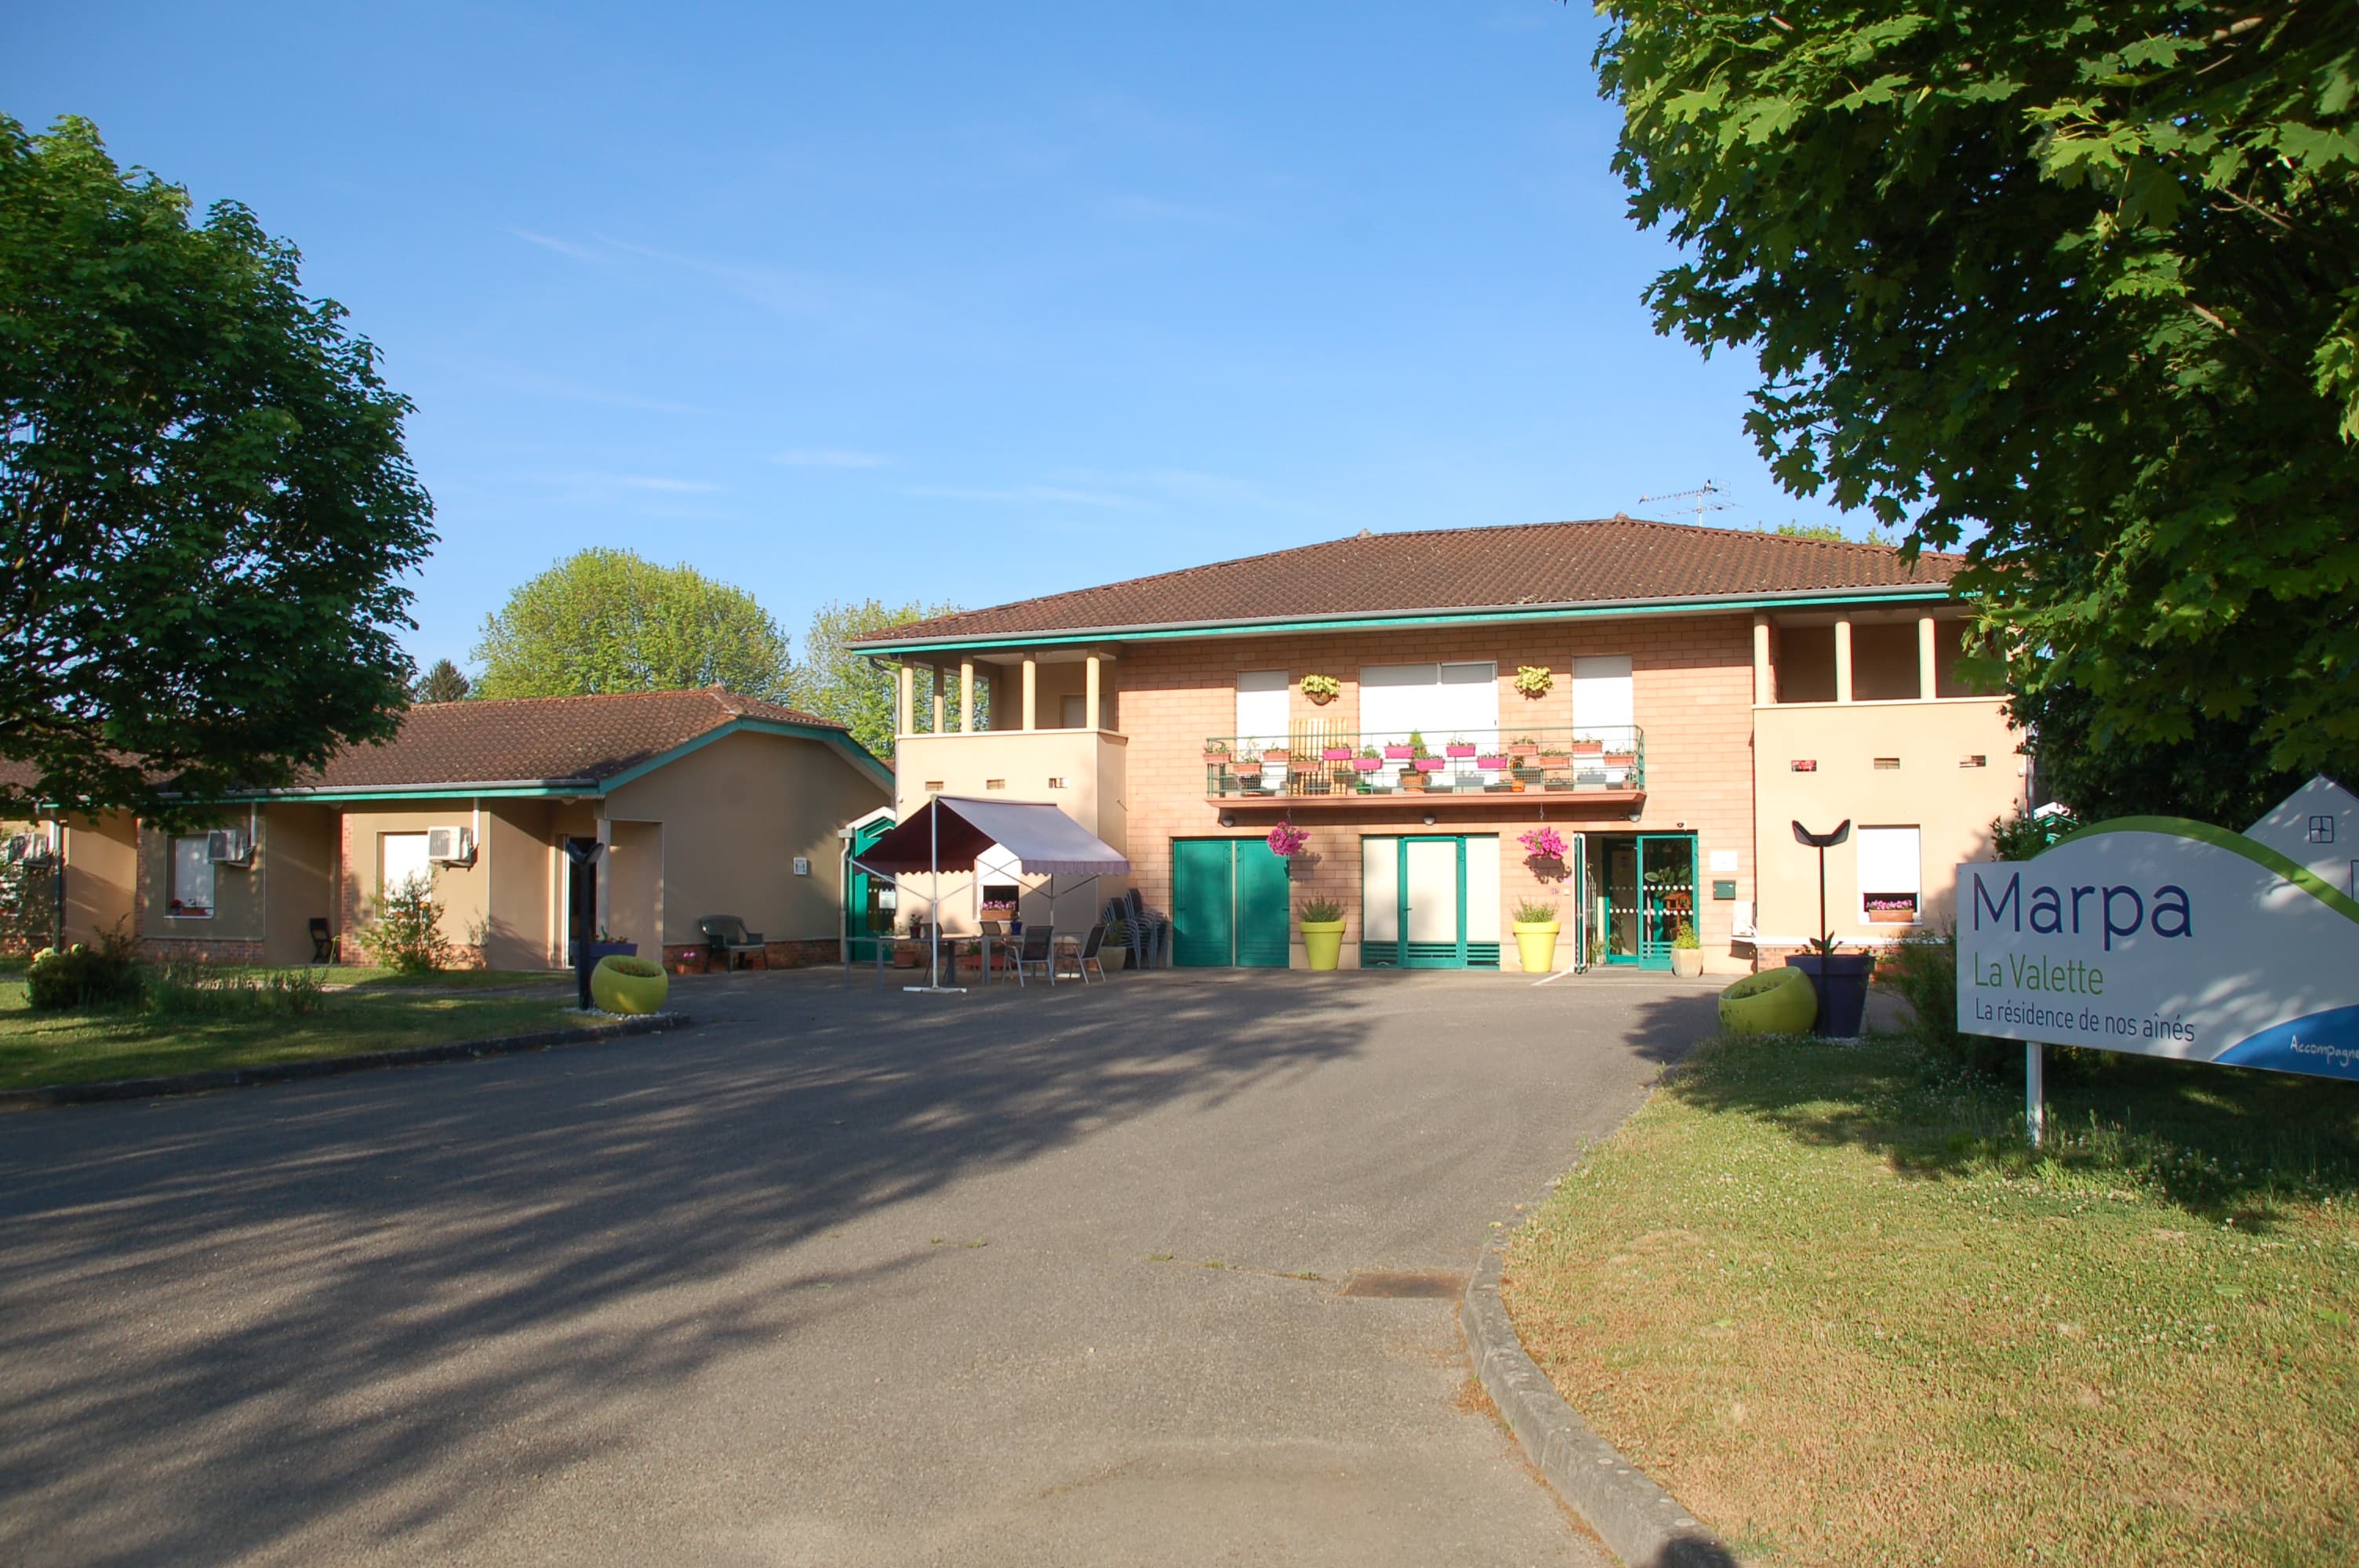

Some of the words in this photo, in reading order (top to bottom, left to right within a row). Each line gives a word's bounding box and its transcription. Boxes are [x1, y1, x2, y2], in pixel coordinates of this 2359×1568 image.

[1973, 872, 2193, 952] Marpa
[1975, 952, 2002, 988] La
[2009, 953, 2103, 995] Valette
[1976, 997, 1993, 1020] La
[1997, 999, 2074, 1029] résidence
[2079, 1007, 2099, 1032] de
[2105, 1014, 2137, 1036] nos
[2143, 1014, 2195, 1041] aînés
